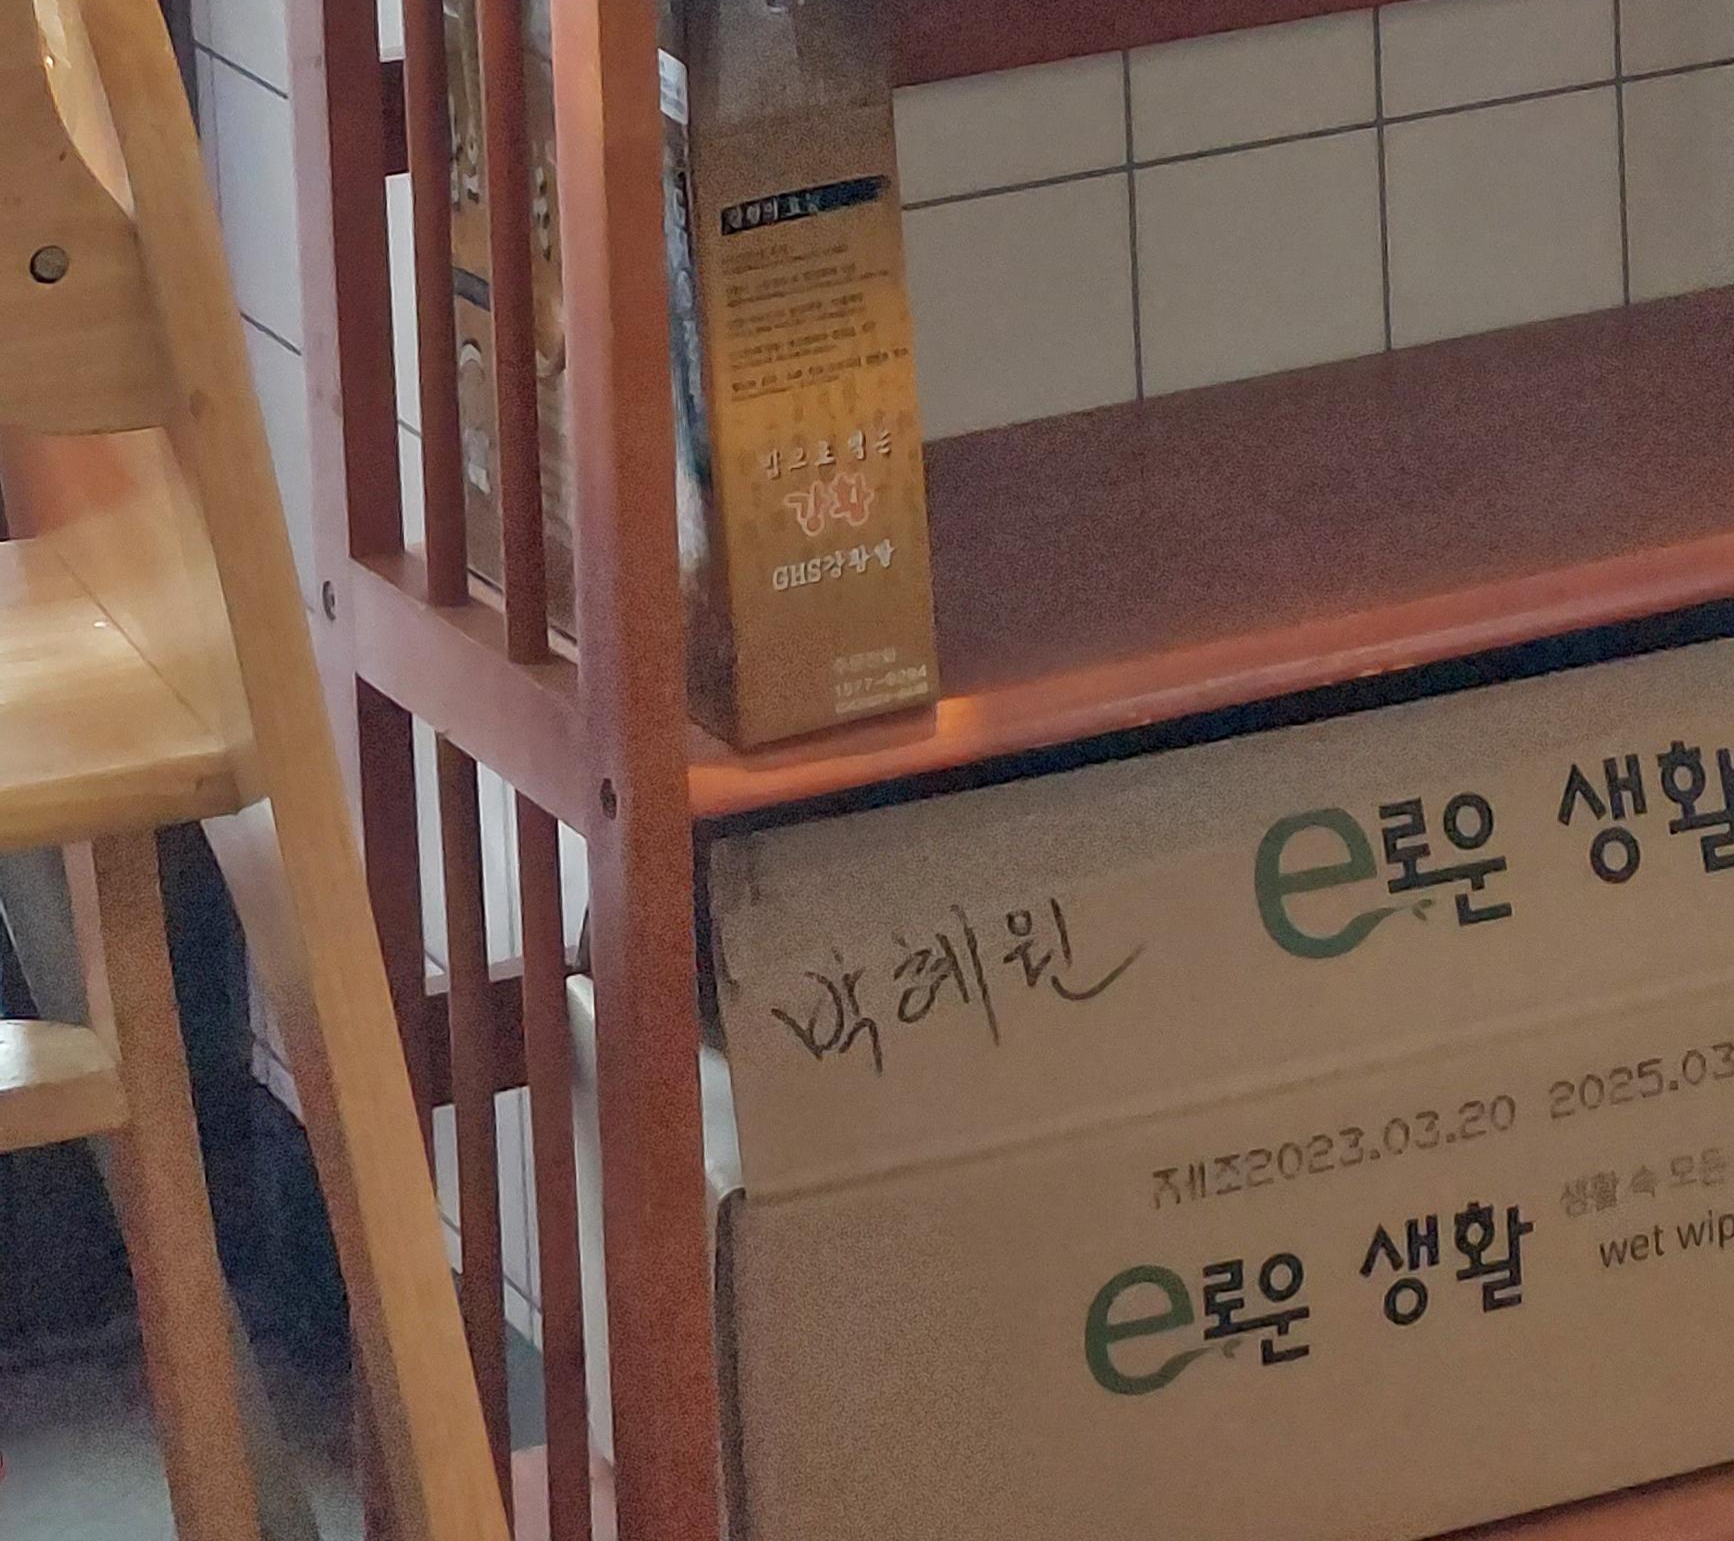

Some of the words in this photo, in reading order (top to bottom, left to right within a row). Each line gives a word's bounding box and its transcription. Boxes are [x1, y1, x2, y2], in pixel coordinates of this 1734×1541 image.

[1254, 790, 1513, 960] e로운
[1084, 1252, 1310, 1397] e로운
[1360, 1200, 1534, 1326] 생활
[1600, 1223, 1664, 1268] wet
